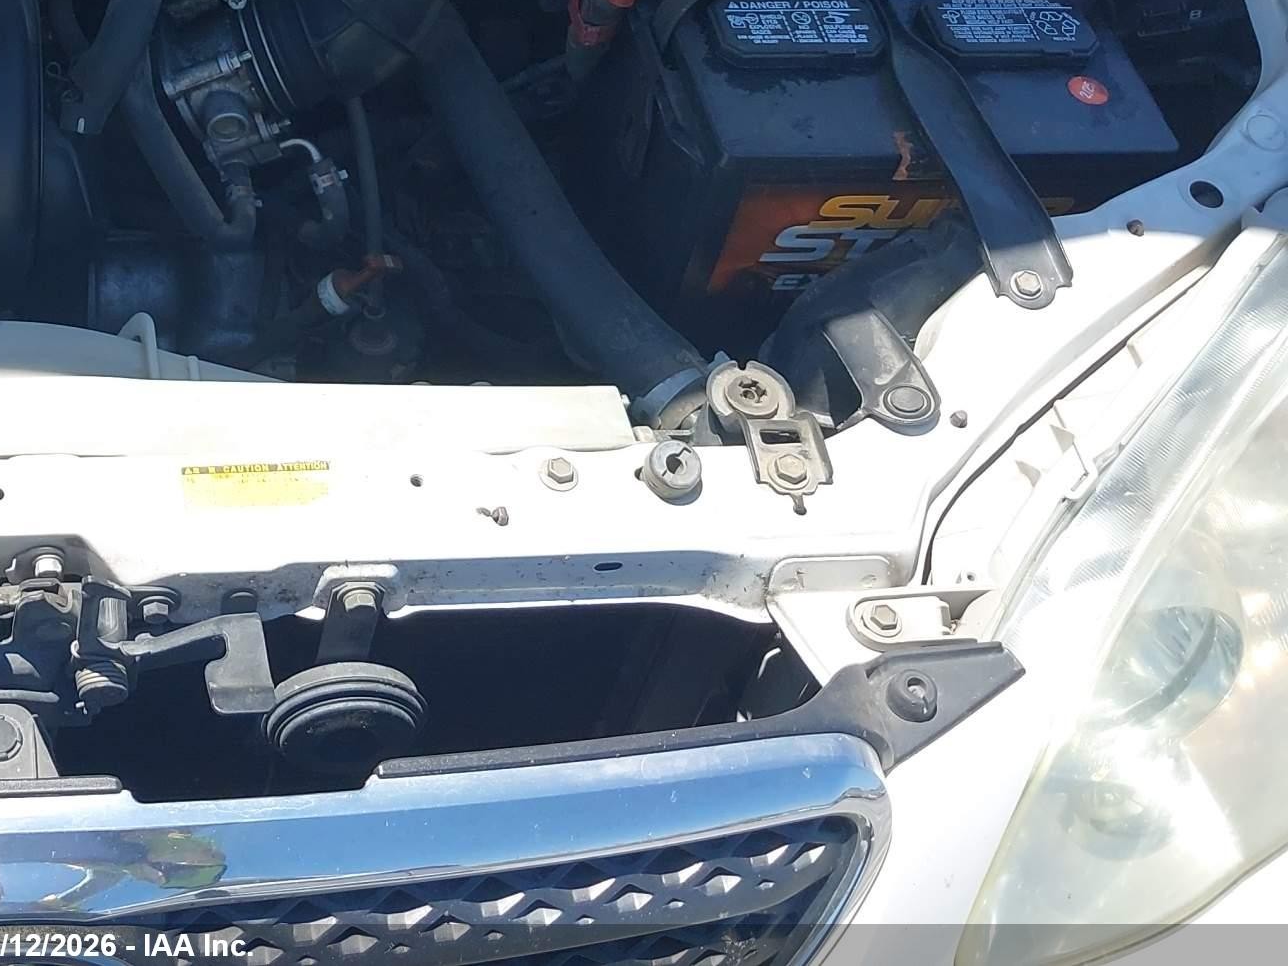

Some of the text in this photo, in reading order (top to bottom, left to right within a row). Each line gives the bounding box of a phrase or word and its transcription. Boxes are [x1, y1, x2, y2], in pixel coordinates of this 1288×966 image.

[739, 0, 792, 10] DANGER
[802, 0, 849, 10] POISON
[223, 463, 270, 474] CAUTION
